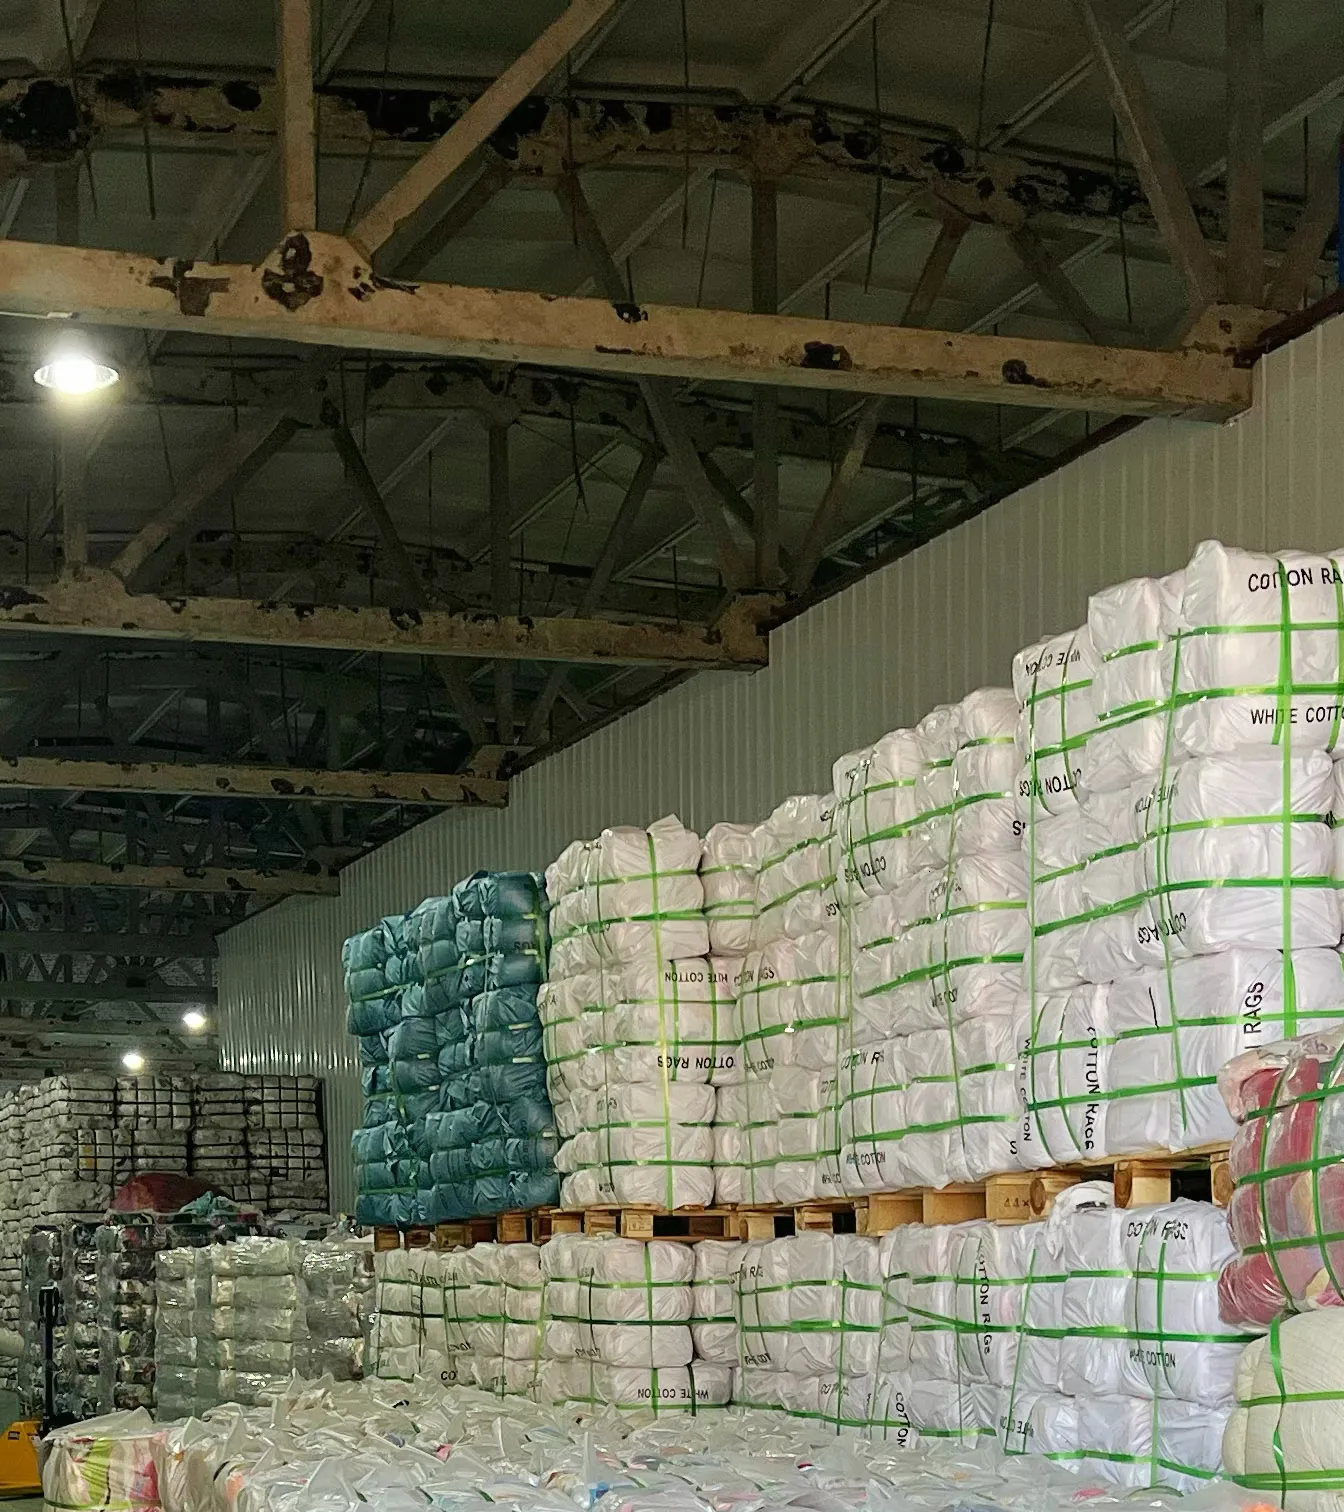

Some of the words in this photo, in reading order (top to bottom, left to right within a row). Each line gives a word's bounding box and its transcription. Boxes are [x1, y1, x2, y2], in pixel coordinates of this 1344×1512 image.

[1250, 706, 1298, 725] WHITE
[665, 972, 703, 983] COTTON
[1244, 981, 1264, 1034] RAGS
[637, 1388, 675, 1398] COTTON
[680, 1389, 709, 1399] WHTE
